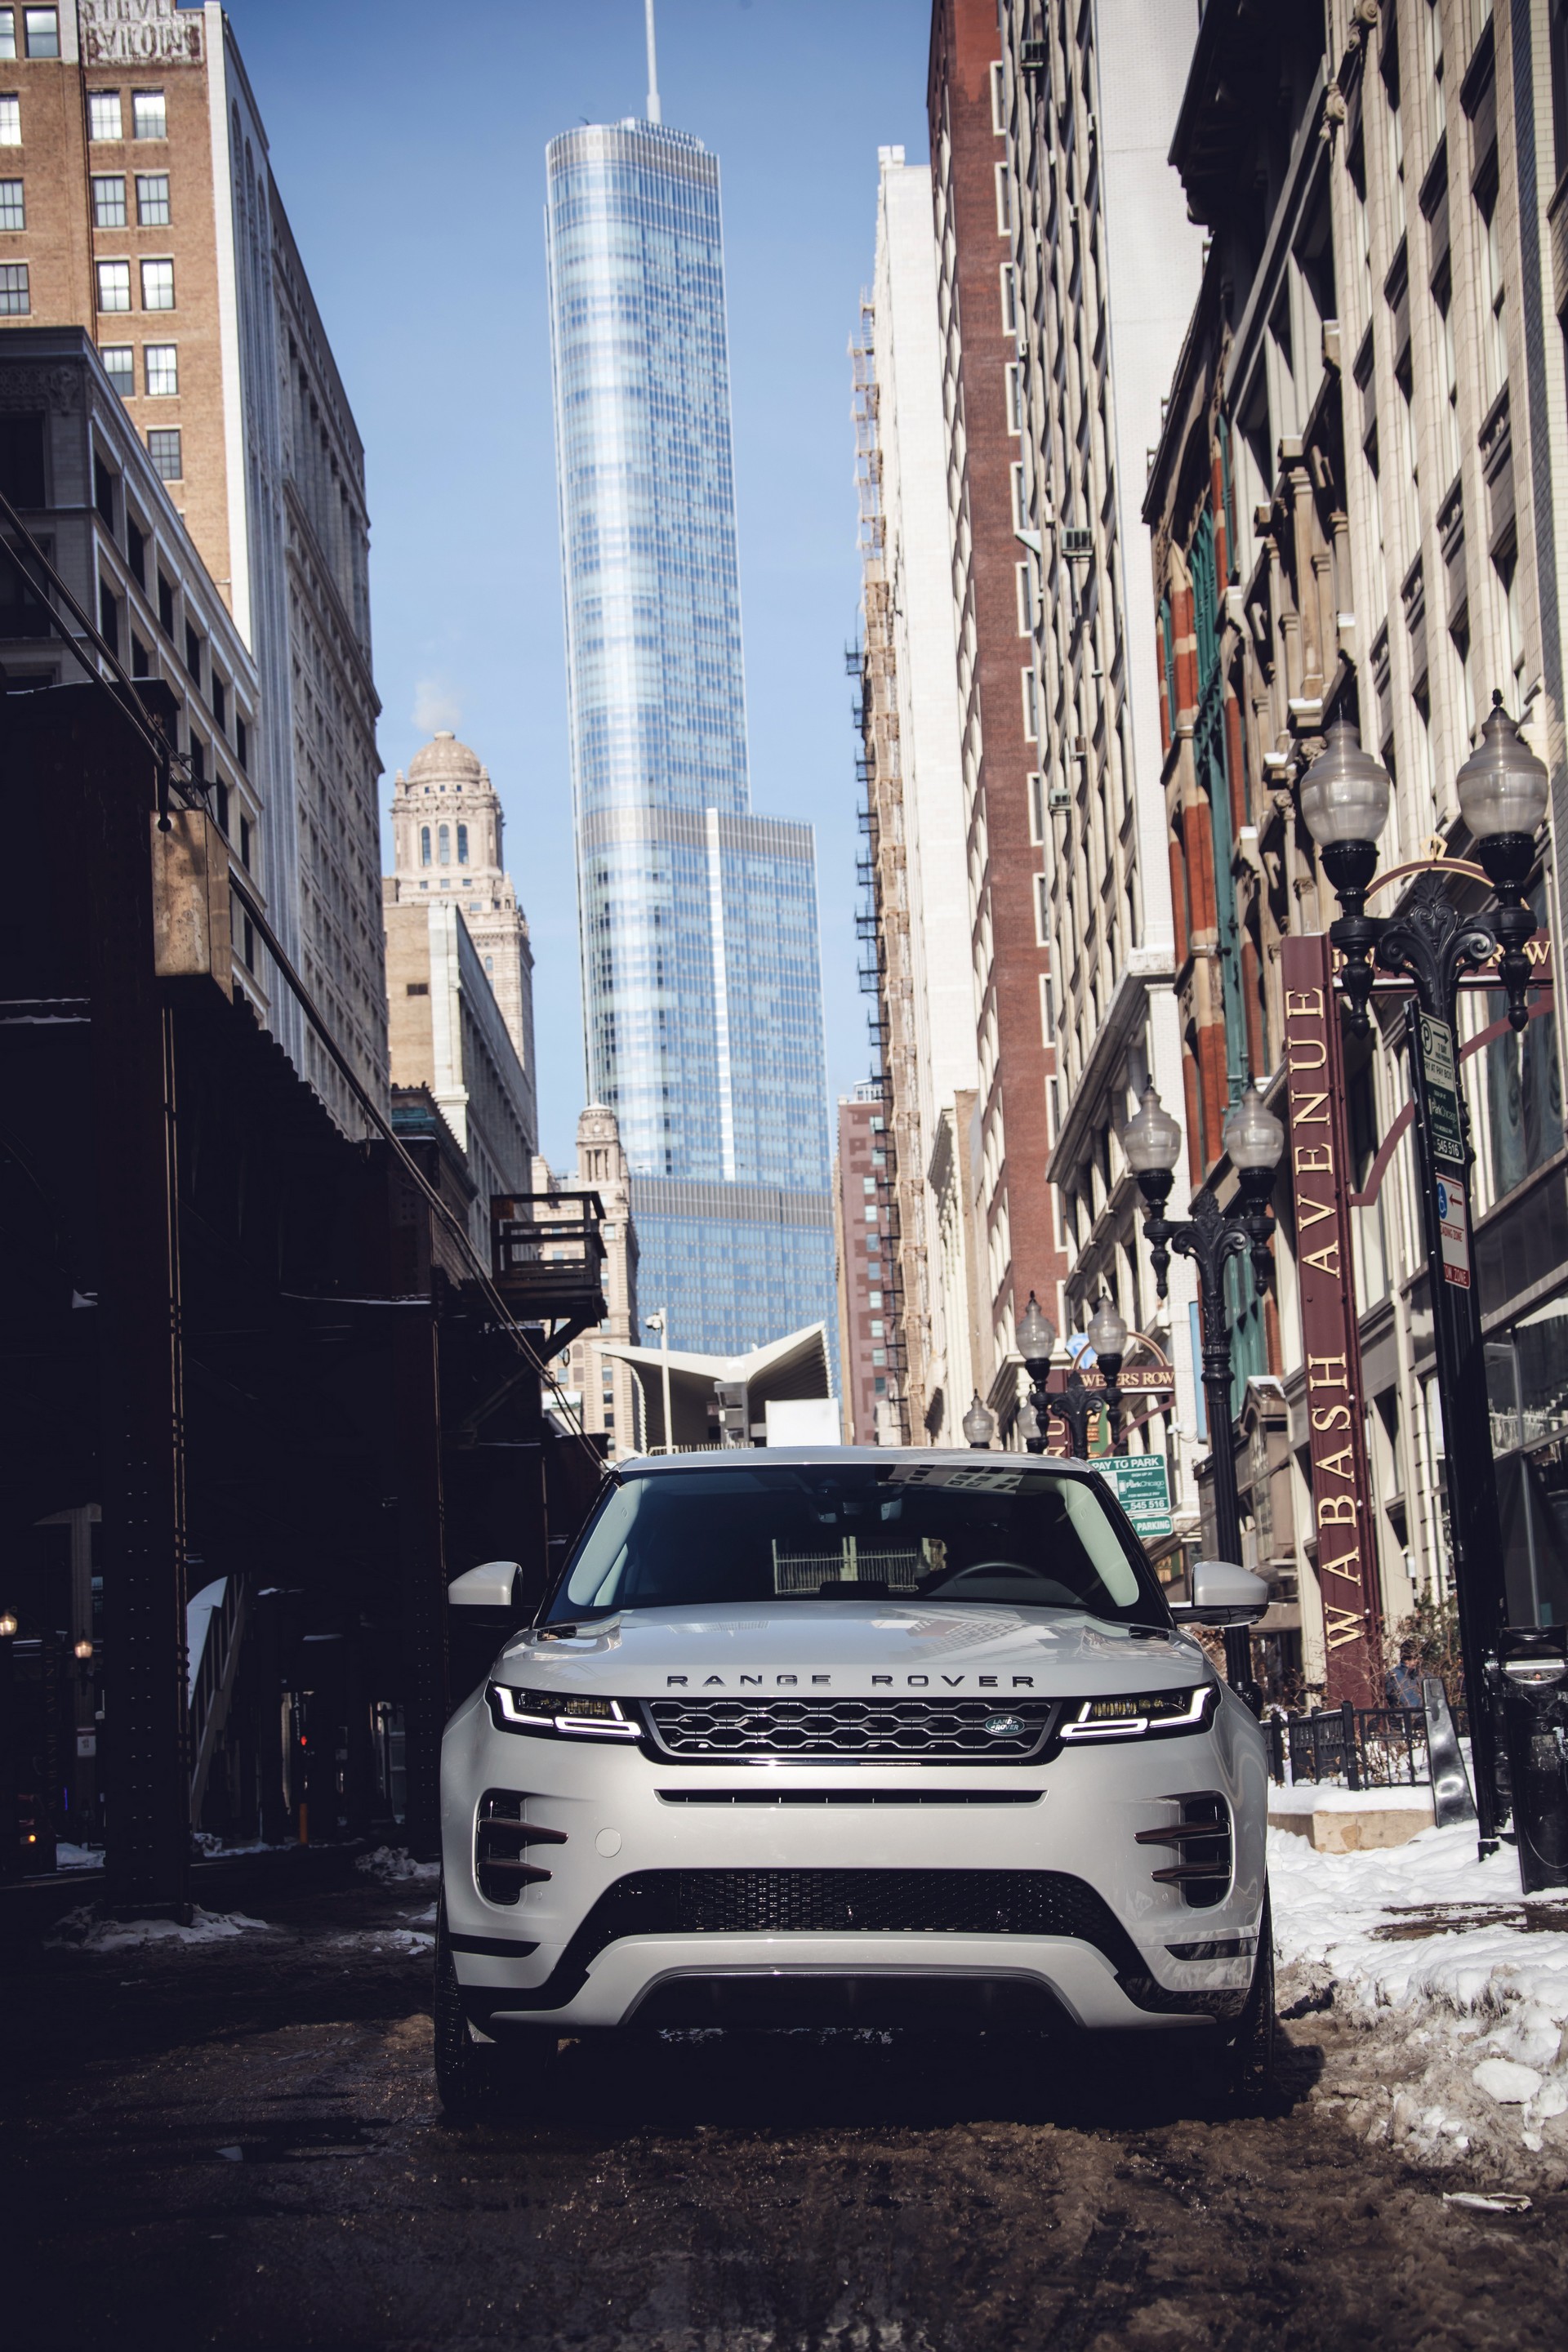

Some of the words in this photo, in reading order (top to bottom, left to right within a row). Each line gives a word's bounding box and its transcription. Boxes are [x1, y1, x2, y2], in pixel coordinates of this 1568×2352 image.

[1486, 941, 1551, 968] RW
[1285, 987, 1340, 1280] AVENUE
[1437, 1138, 1448, 1154] 545
[1448, 1142, 1459, 1157] 516
[1453, 1229, 1463, 1242] ZONE
[1444, 1264, 1452, 1280] OW
[1454, 1268, 1468, 1285] ZONE
[1142, 1372, 1175, 1386] ROW
[1092, 1461, 1112, 1471] PAY
[1114, 1459, 1129, 1469] TO
[1131, 1457, 1159, 1468] PARK
[1130, 1501, 1147, 1510] 545
[1148, 1499, 1165, 1508] 516
[1307, 1352, 1365, 1653] WABASH
[1136, 1520, 1170, 1532] PARKING
[666, 1675, 831, 1688] RANGE
[871, 1675, 1035, 1688] ROVER
